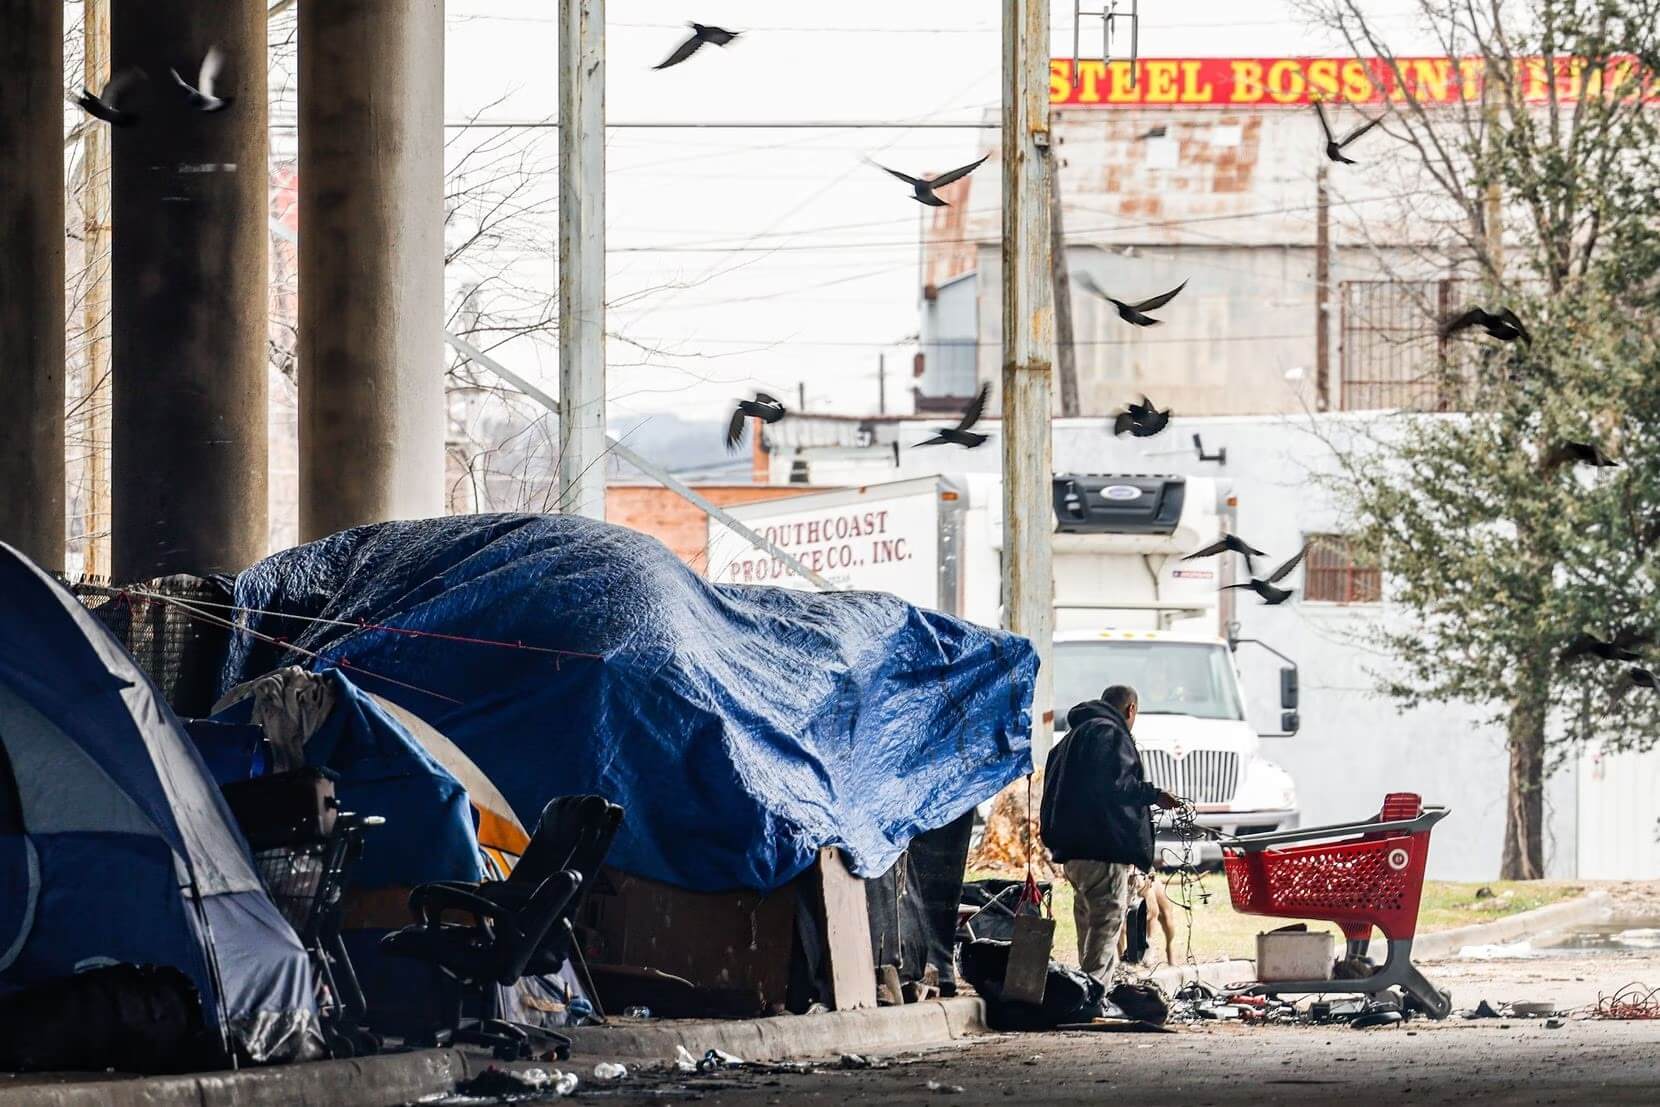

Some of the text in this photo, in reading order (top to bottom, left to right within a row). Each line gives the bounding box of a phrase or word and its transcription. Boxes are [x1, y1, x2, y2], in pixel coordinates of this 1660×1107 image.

[1050, 60, 1212, 103] STEEL
[1230, 60, 1372, 103] BOSS
[872, 538, 912, 565] INC.
